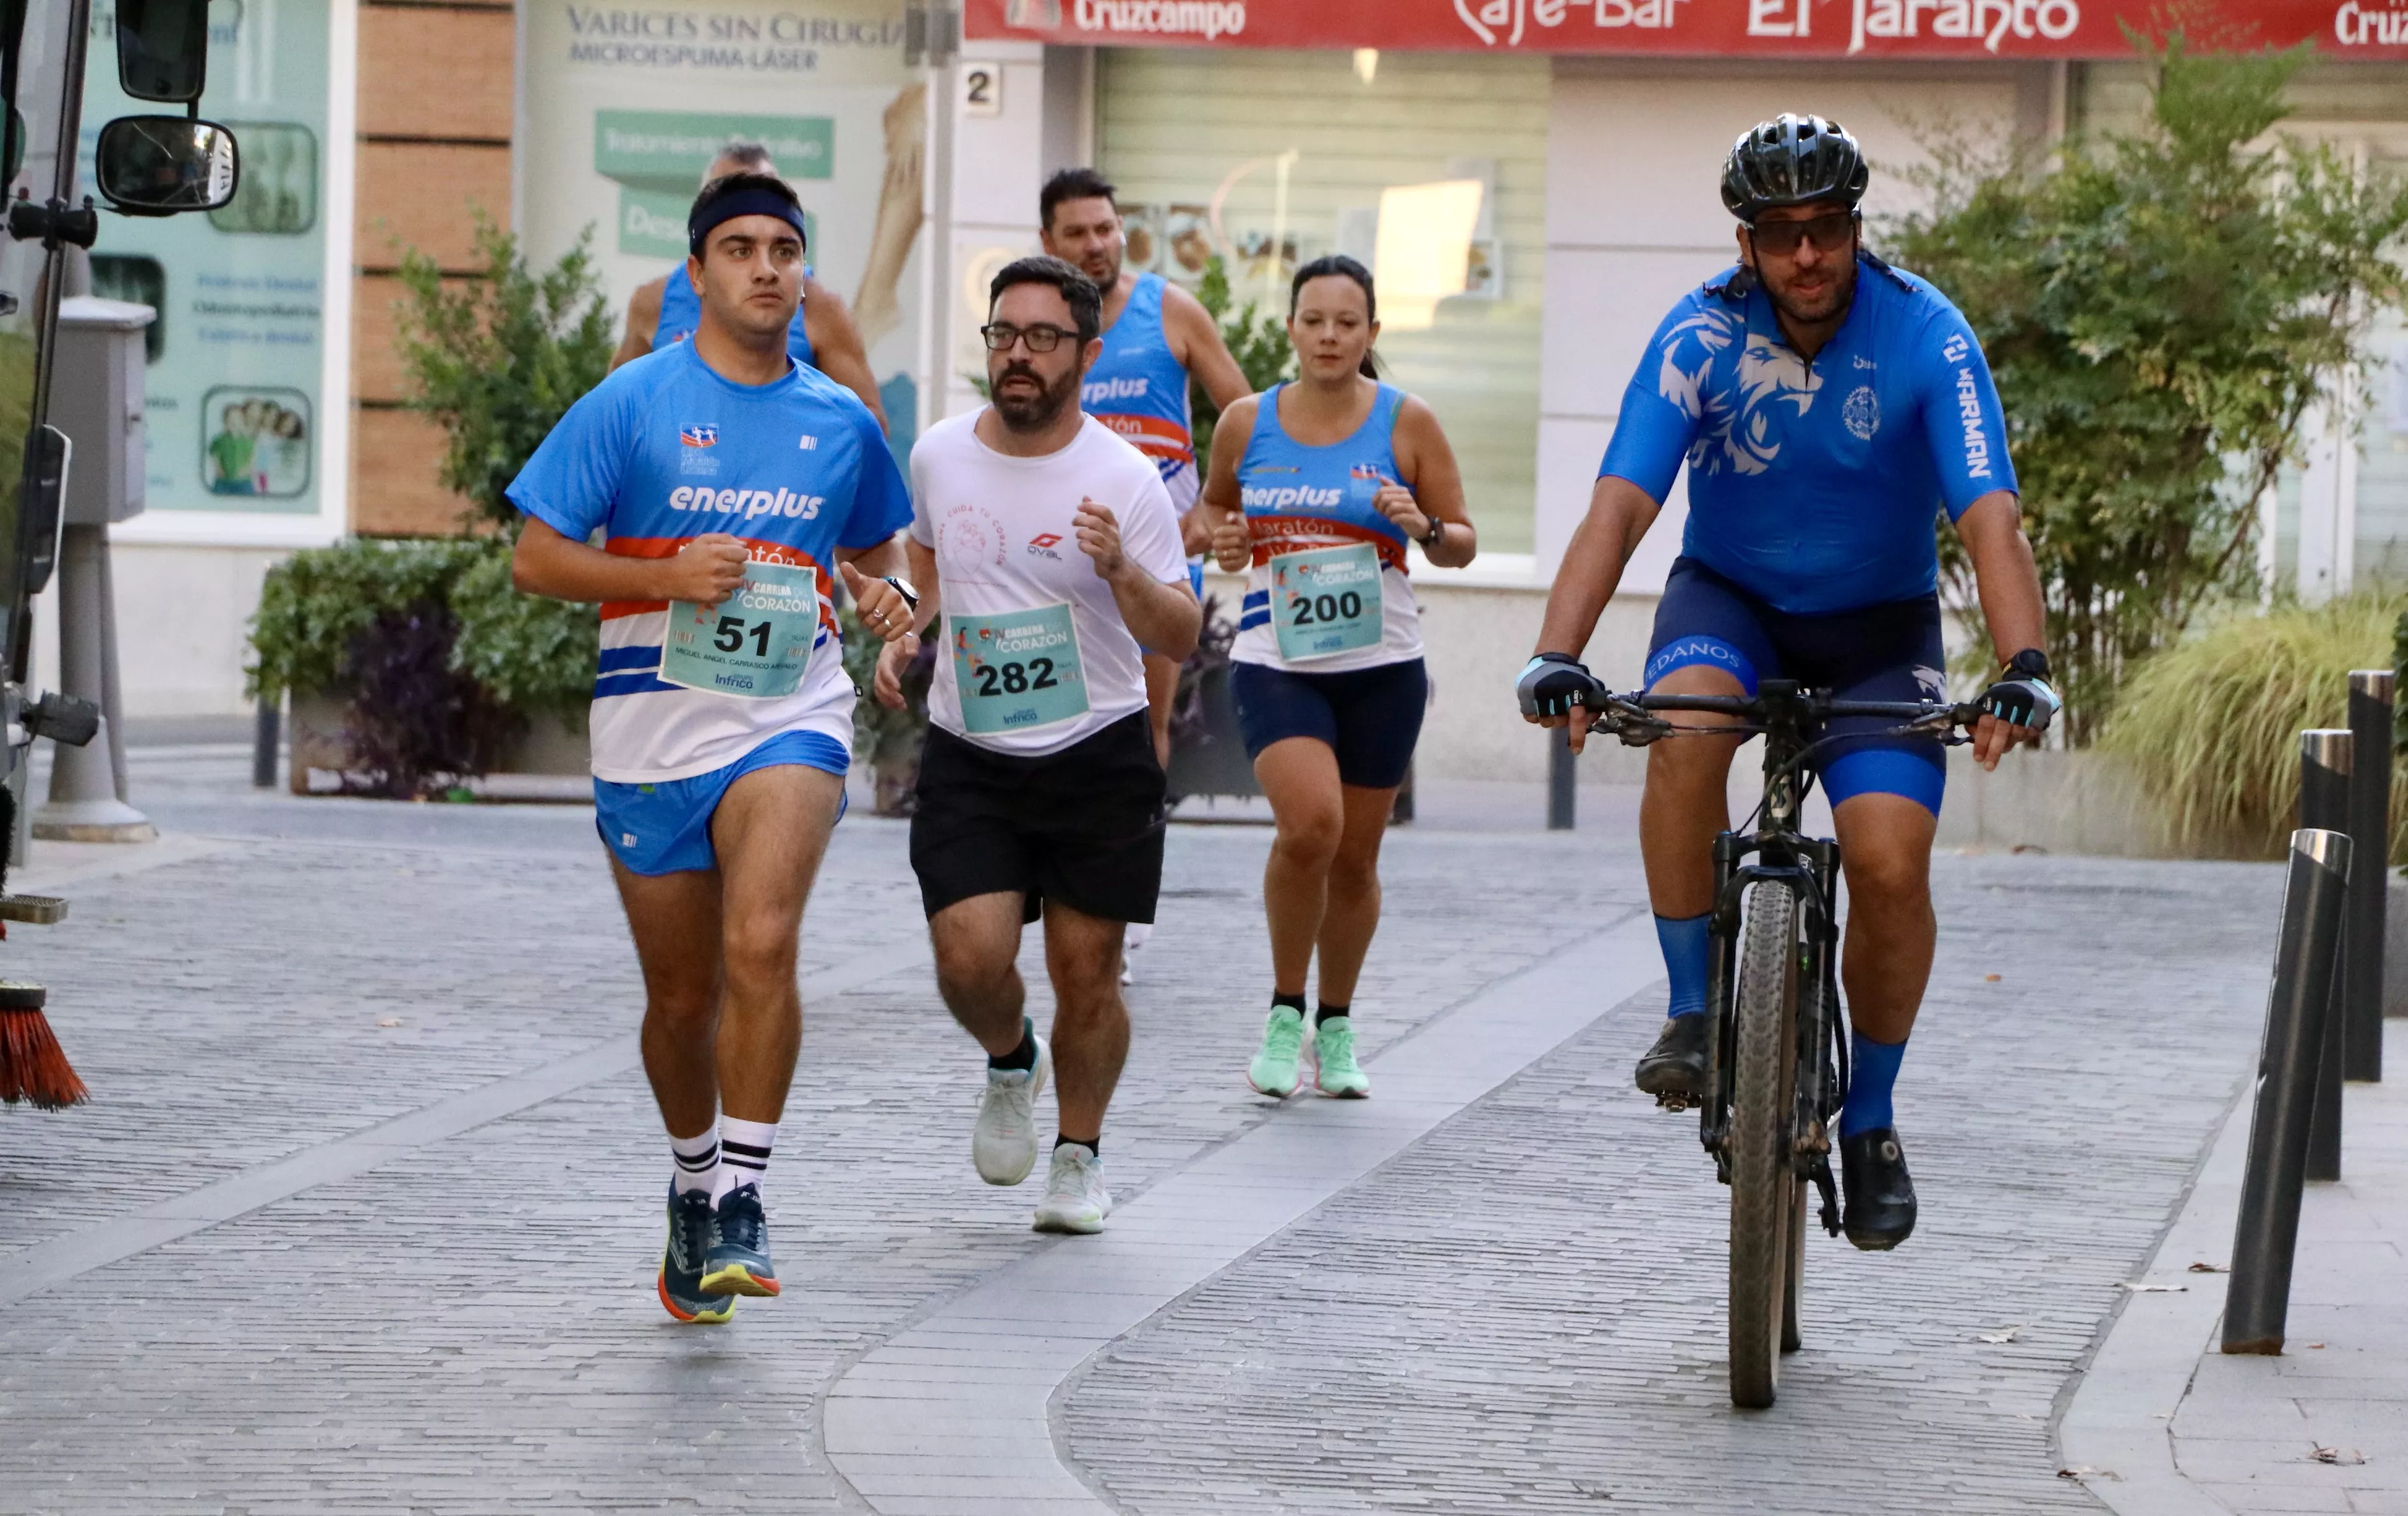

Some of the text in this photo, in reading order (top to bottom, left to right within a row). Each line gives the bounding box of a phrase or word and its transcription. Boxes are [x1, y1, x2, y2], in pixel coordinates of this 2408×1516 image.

[1074, 0, 1246, 41] Cruzcampo
[968, 71, 990, 103] 2
[670, 486, 824, 520] enerplus
[1242, 485, 1342, 511] nerplus
[1293, 590, 1361, 626] 200
[713, 615, 772, 657] 51
[675, 647, 701, 659] MIGUEL
[729, 659, 770, 671] CARRASCO
[1646, 643, 1740, 680] EDANOS
[715, 673, 754, 690] Infrico
[976, 657, 1058, 697] 282
